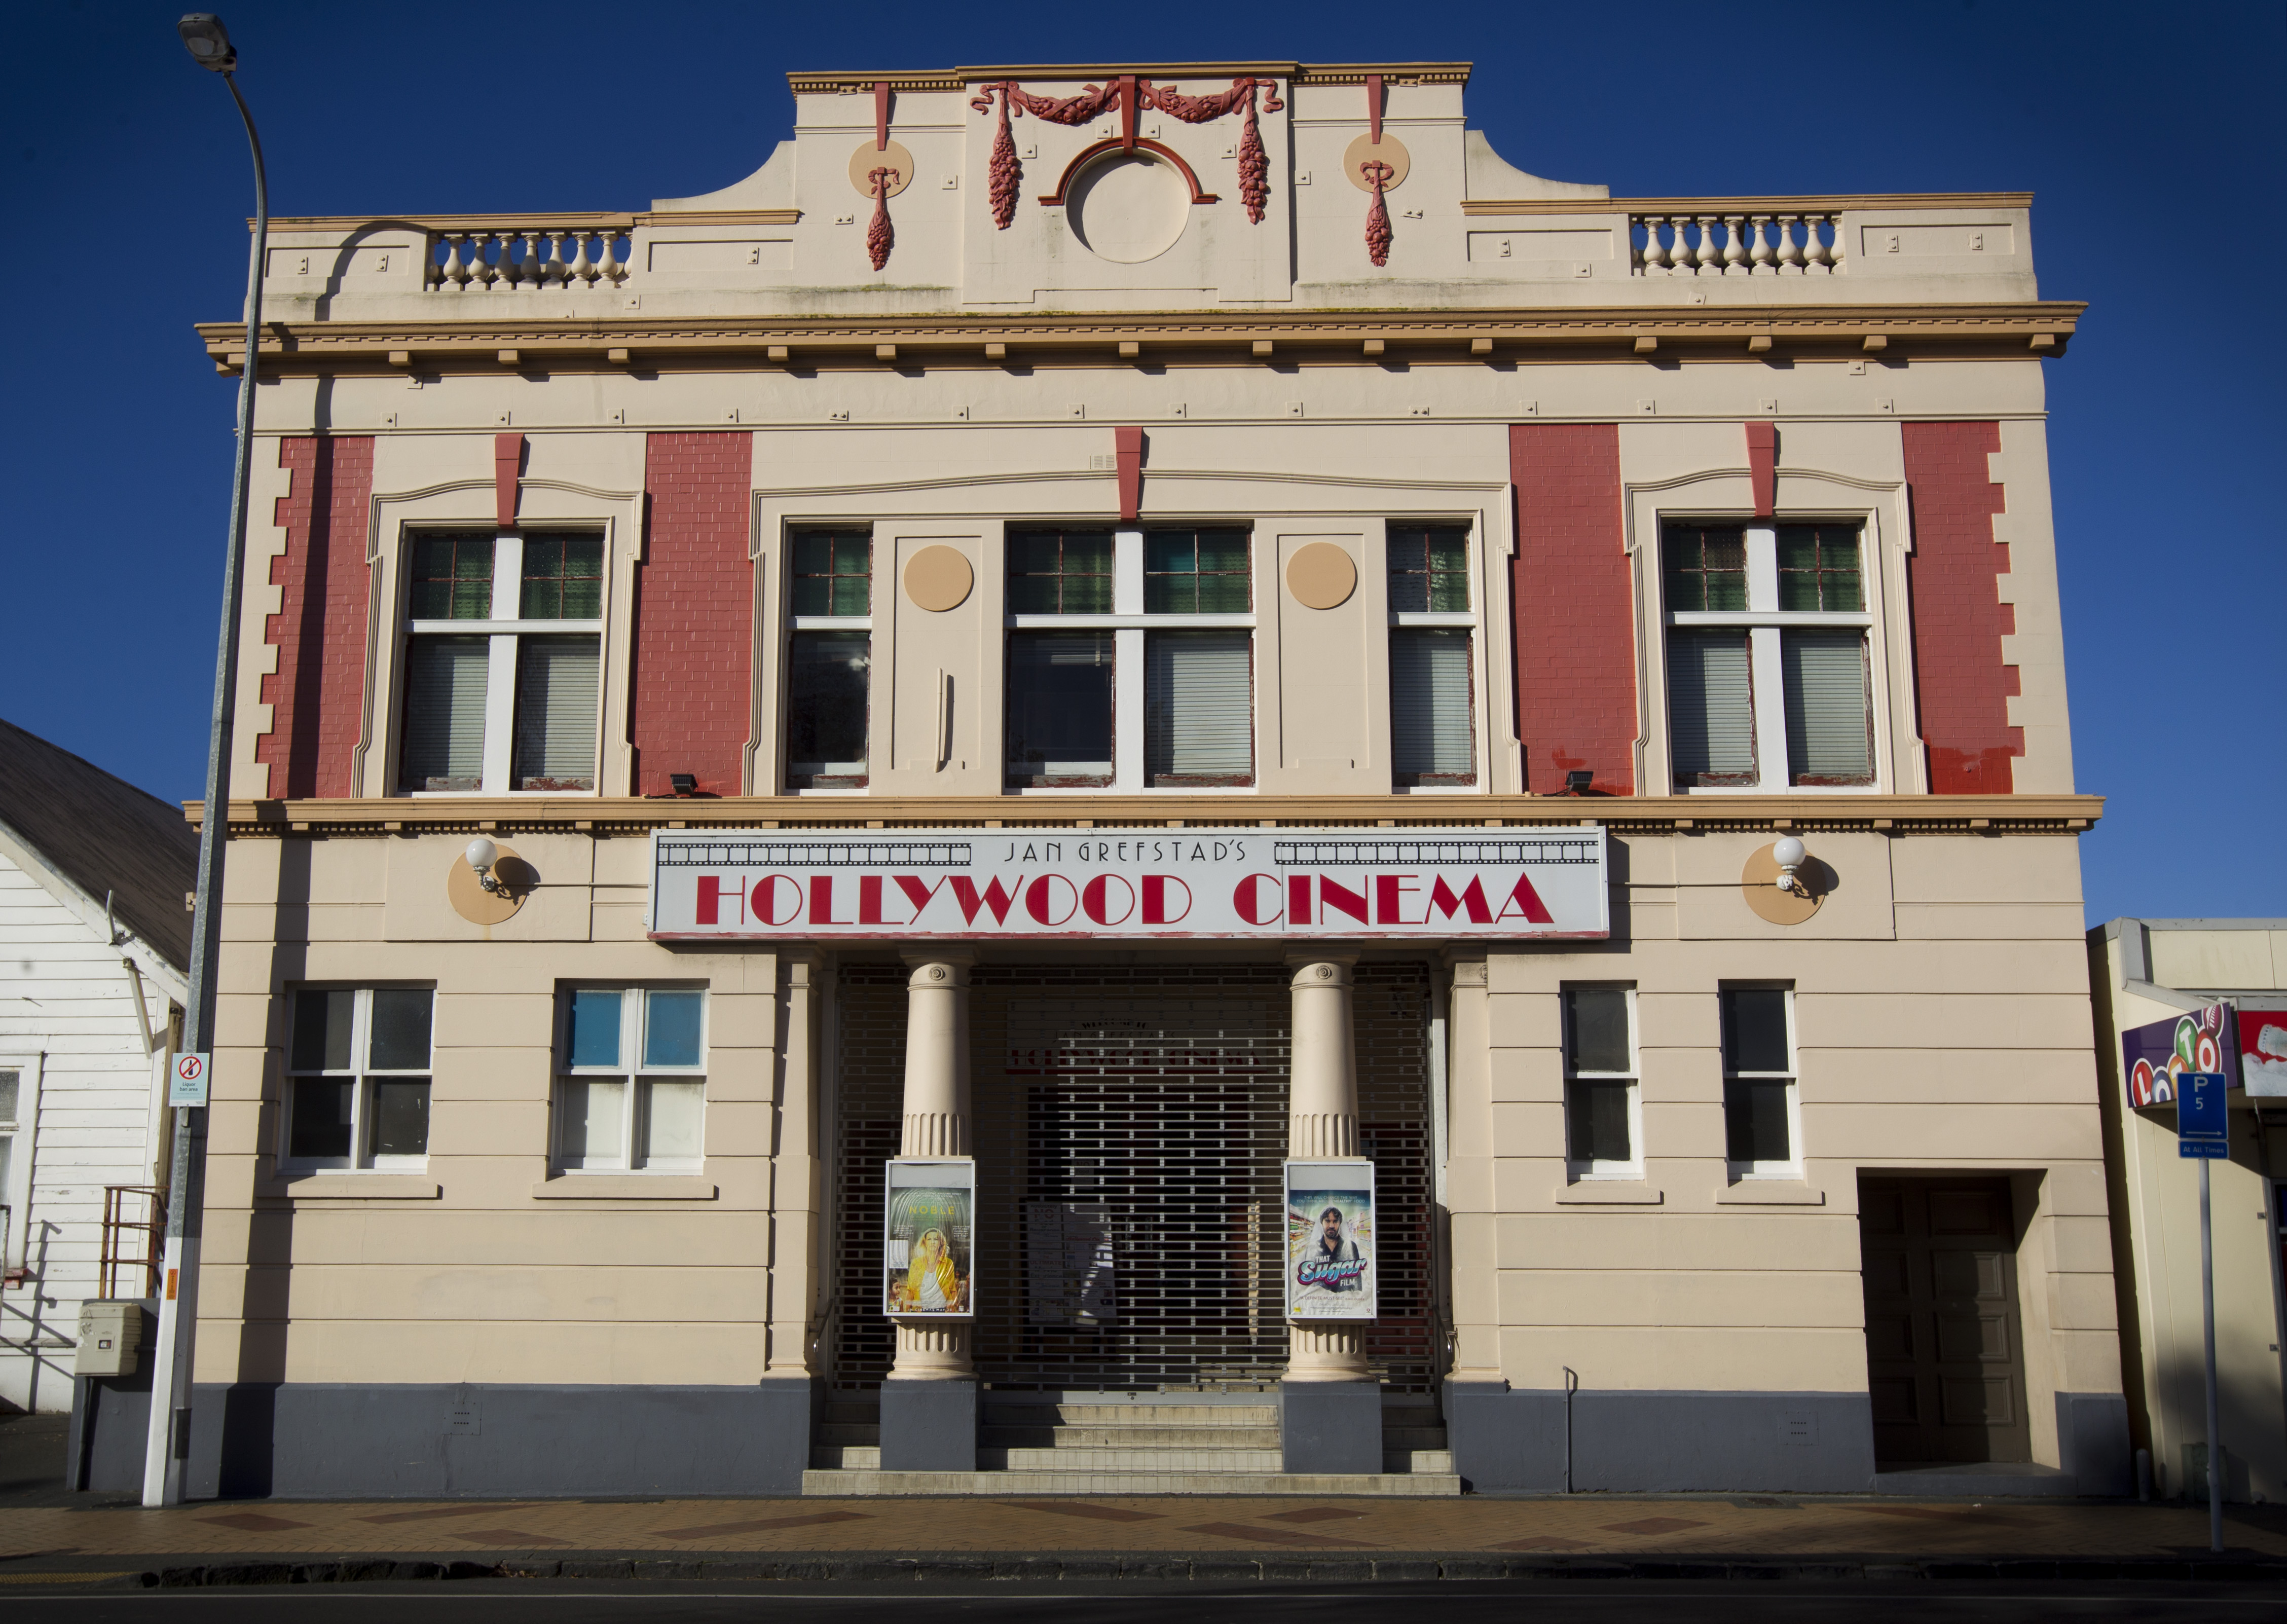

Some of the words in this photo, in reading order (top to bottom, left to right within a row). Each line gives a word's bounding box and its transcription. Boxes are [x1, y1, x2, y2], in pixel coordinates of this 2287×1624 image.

[1004, 842, 1061, 862] JAN
[1078, 839, 1246, 862] GREFSTAD'S
[695, 873, 1192, 928] HOLLYWOOD
[1233, 871, 1555, 926] CINEMA
[2194, 1076, 2208, 1092] P
[2196, 1097, 2203, 1110] 5
[909, 1205, 955, 1215] NOBLE
[1315, 1255, 1331, 1263] THAT
[1298, 1259, 1367, 1284] Sugar
